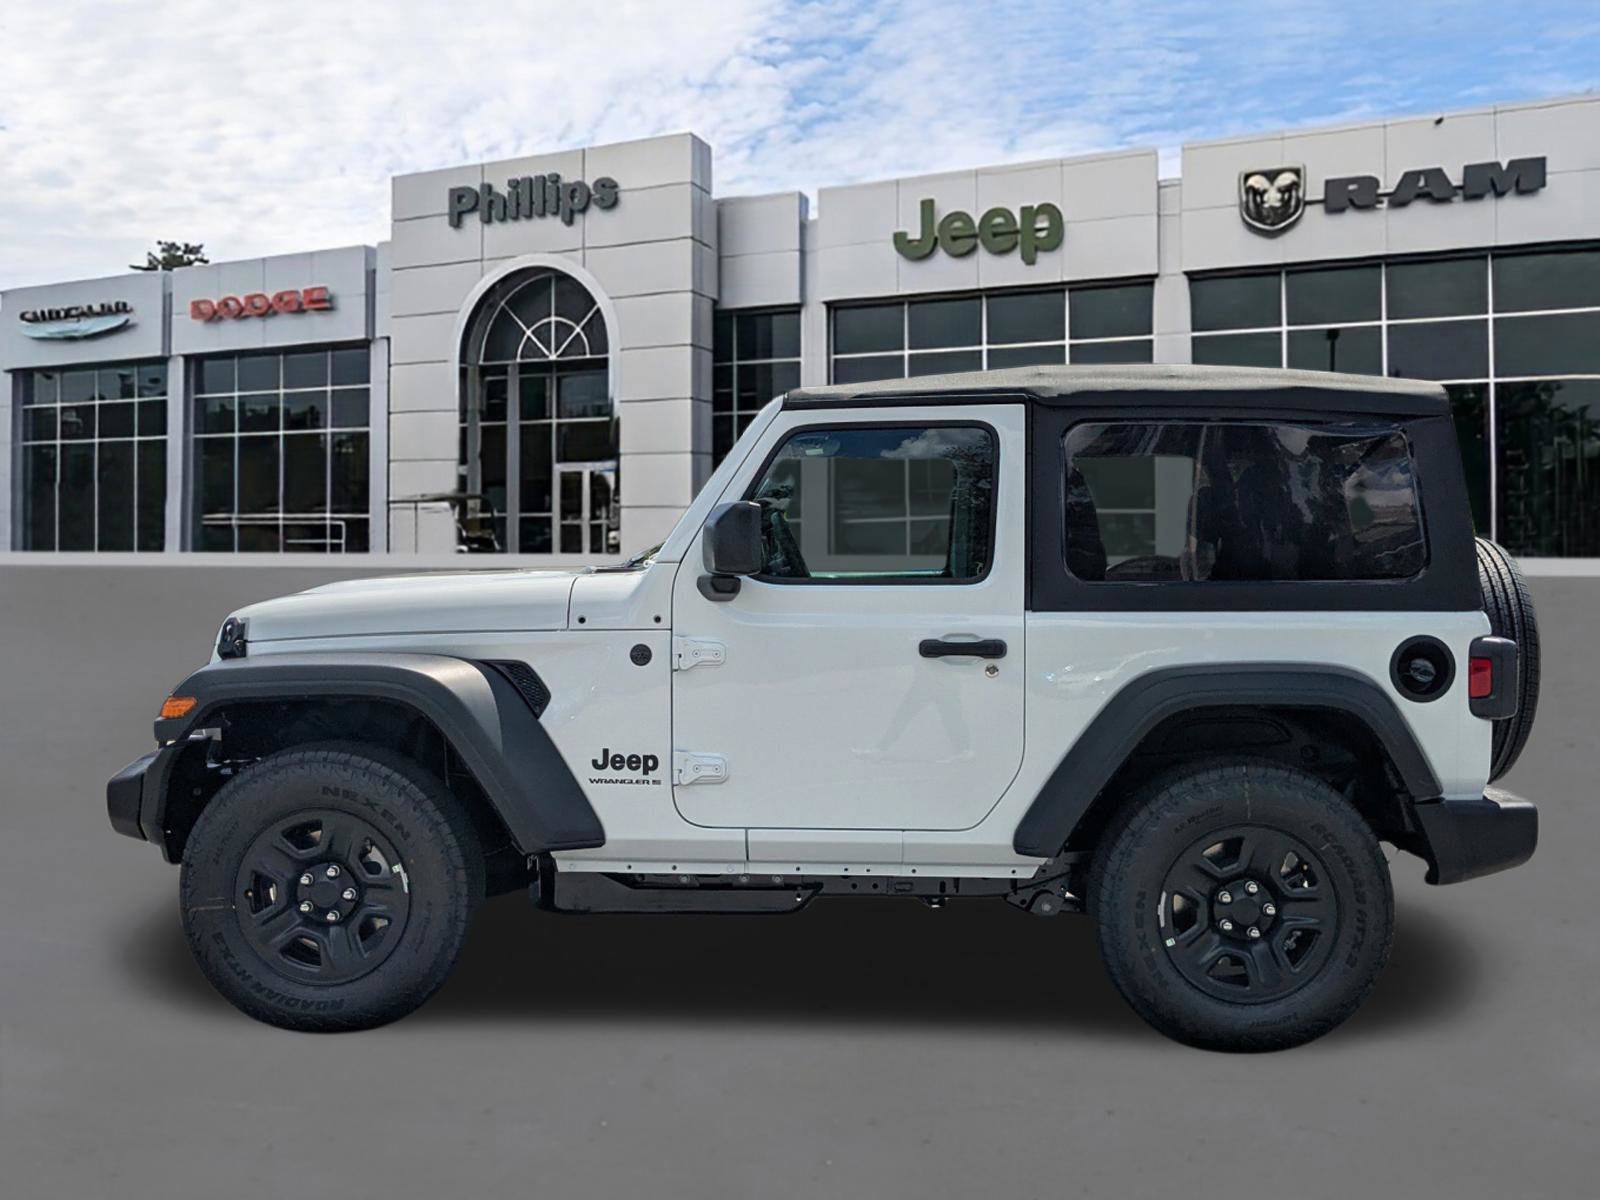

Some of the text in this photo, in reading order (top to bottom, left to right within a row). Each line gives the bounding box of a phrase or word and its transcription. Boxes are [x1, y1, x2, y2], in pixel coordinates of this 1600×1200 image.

[448, 173, 619, 228] Phillips
[1324, 156, 1547, 213] RAM
[893, 198, 1065, 265] Jeep
[190, 286, 332, 323] DODGE
[591, 748, 659, 776] Jeep
